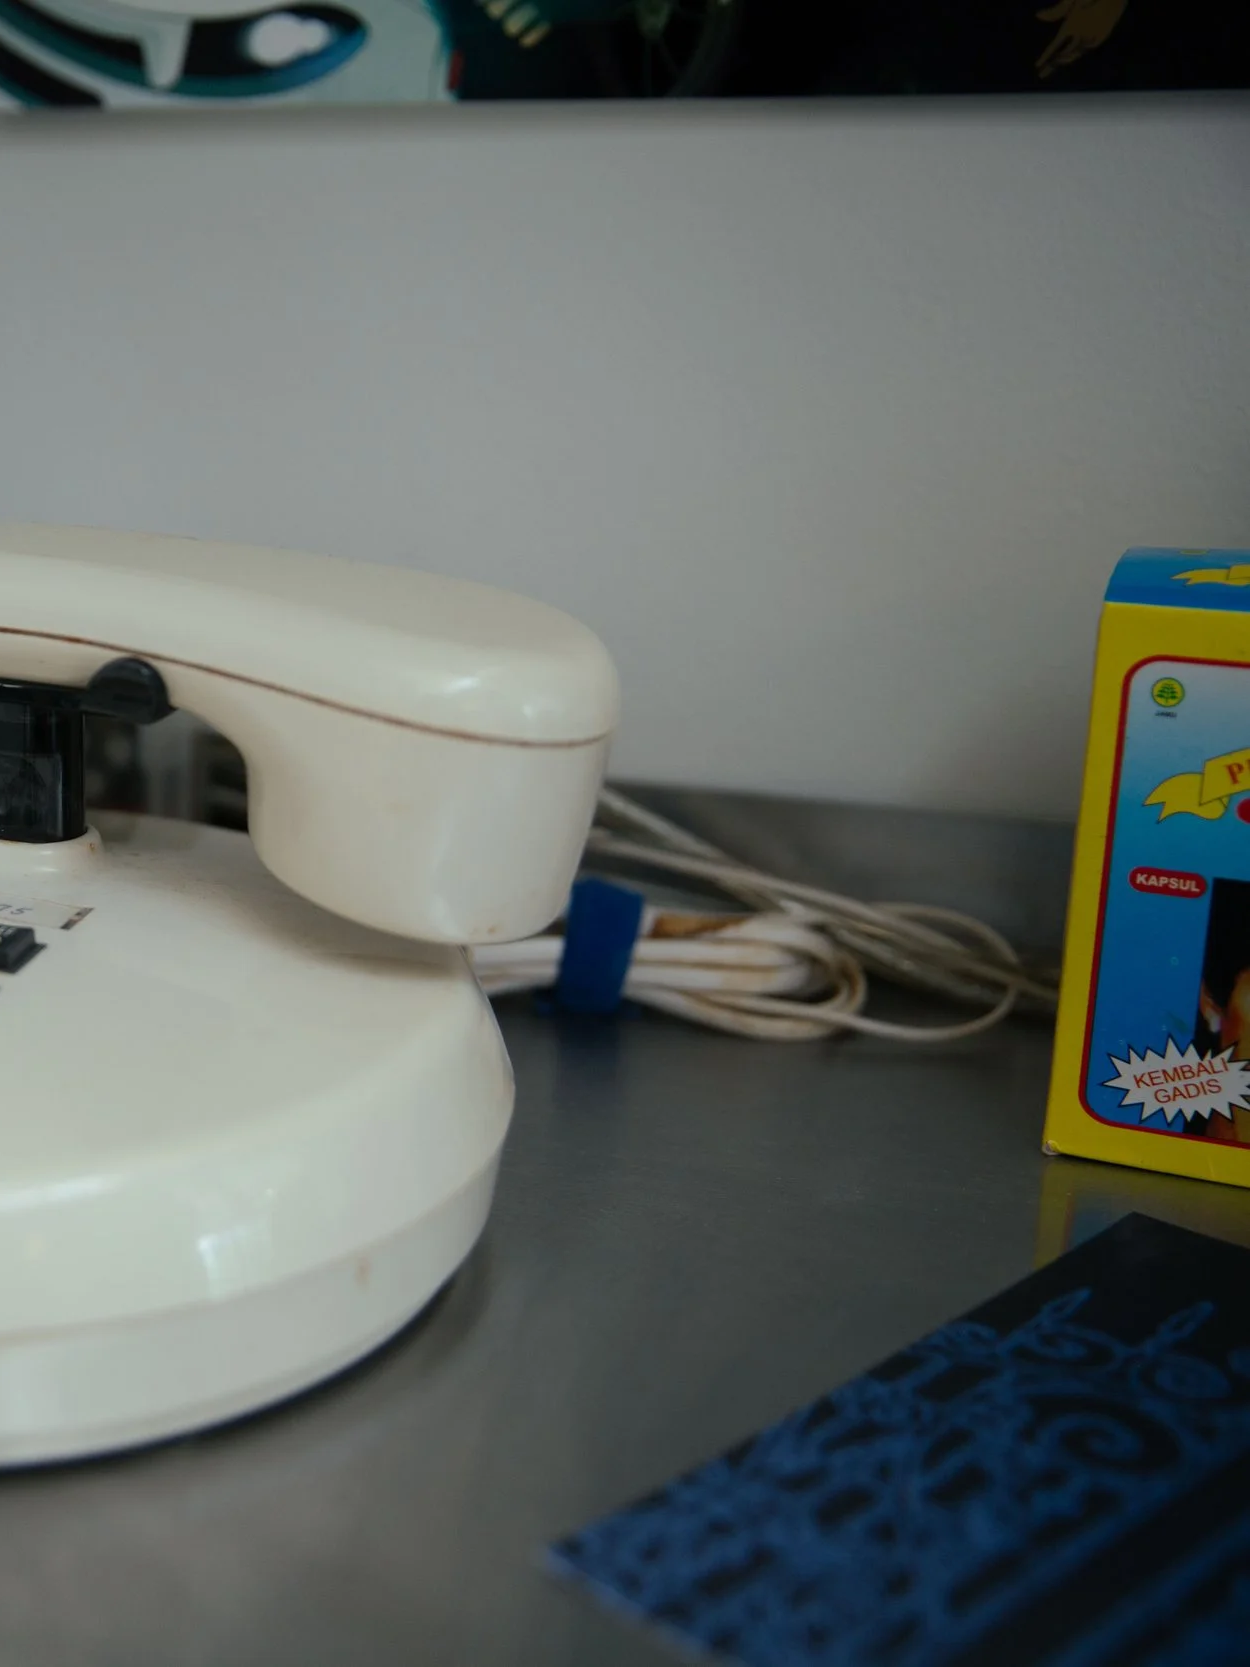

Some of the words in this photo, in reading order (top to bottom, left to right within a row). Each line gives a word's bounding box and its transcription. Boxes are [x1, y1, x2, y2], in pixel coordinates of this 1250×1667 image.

[1223, 758, 1250, 785] P
[1135, 873, 1201, 892] KAPSUL
[1133, 1057, 1229, 1089] KEMBALI
[1154, 1078, 1222, 1104] GADIS
